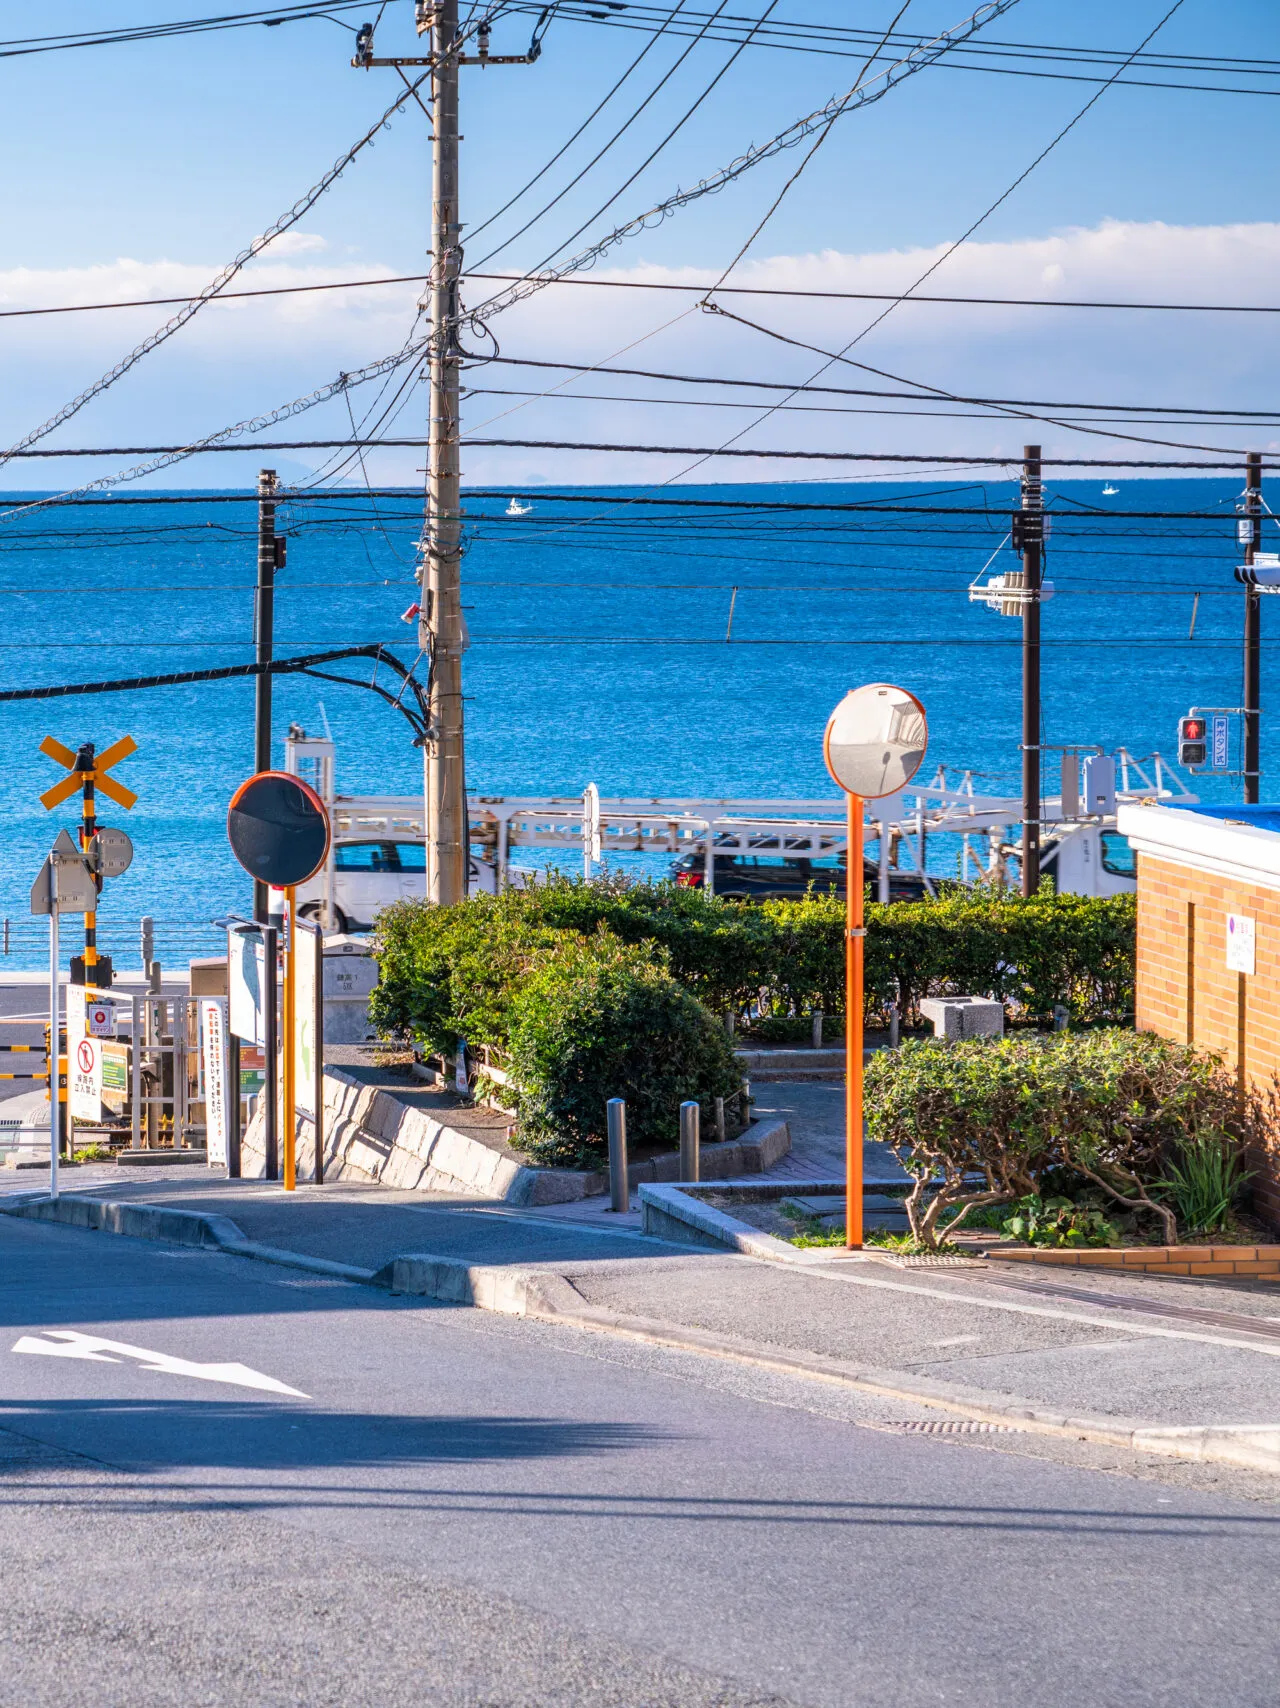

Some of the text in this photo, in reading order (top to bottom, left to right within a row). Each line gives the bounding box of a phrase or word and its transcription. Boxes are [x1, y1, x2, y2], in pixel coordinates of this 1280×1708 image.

[1216, 720, 1225, 764] 押ボタン式
[77, 1074, 94, 1085] 線路内
[74, 1083, 97, 1096] 立入禁止
